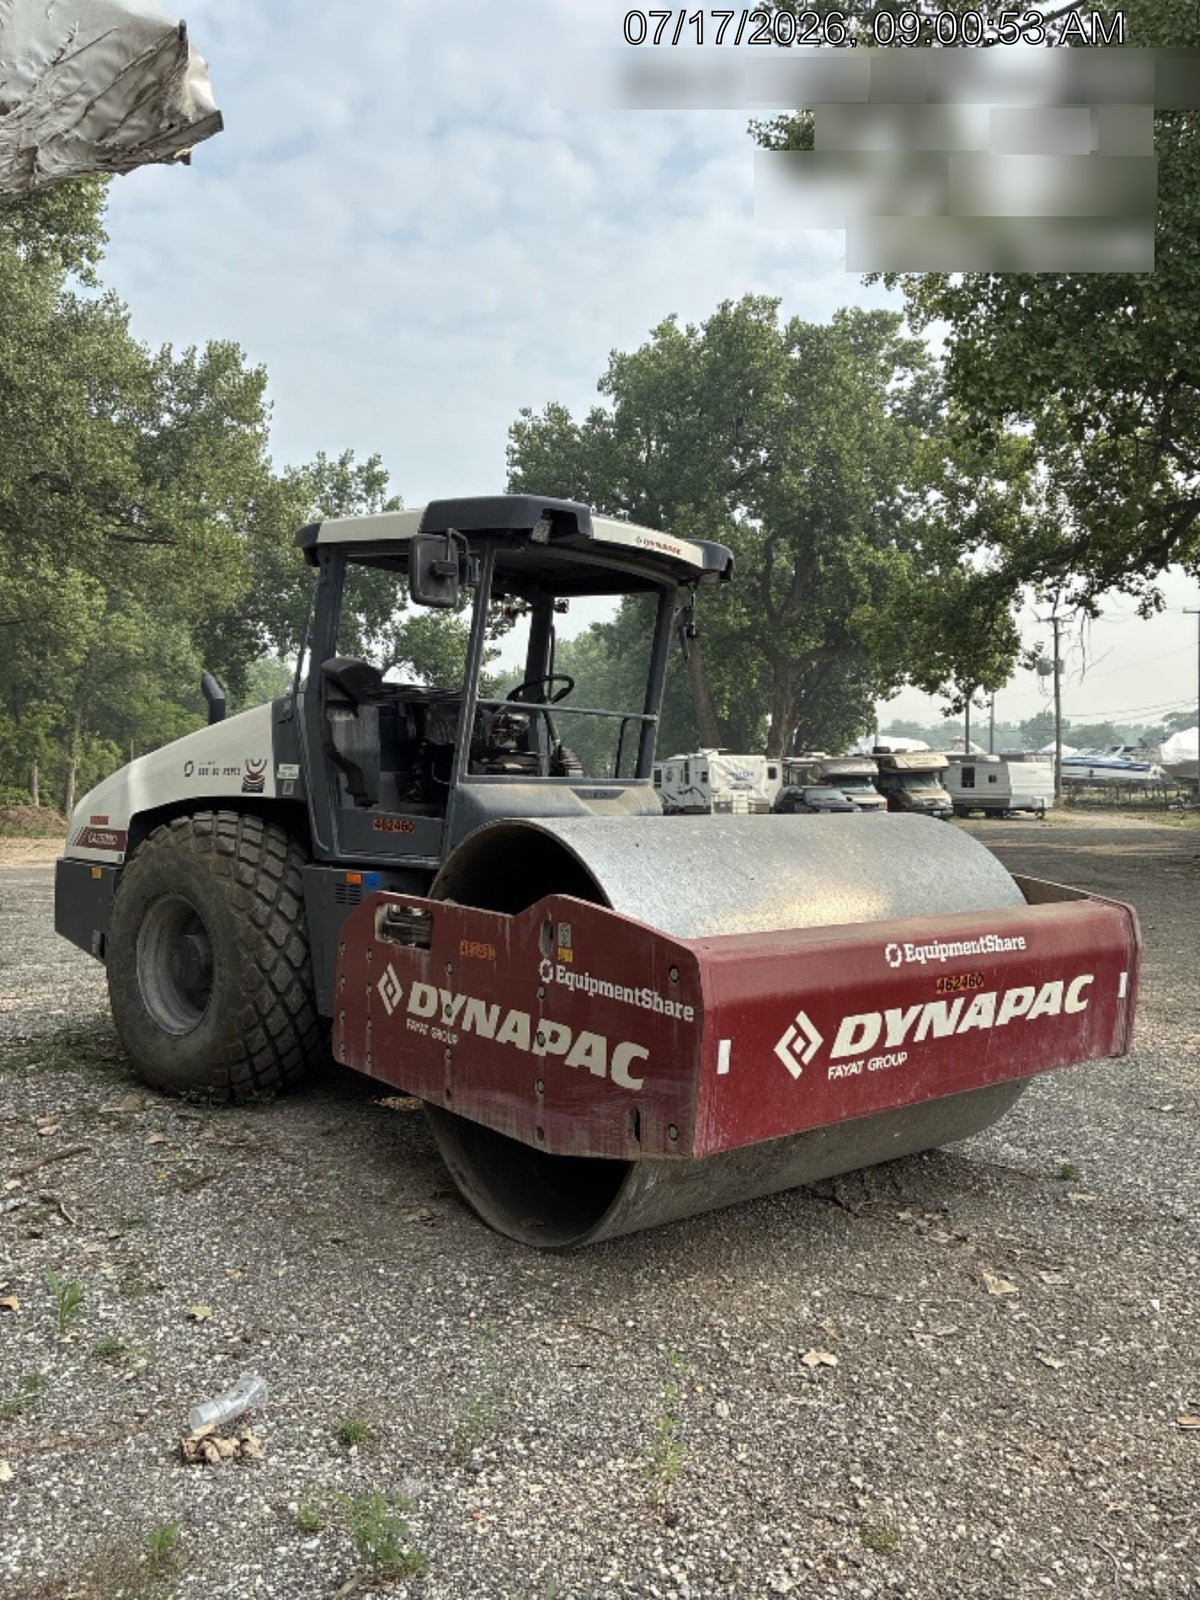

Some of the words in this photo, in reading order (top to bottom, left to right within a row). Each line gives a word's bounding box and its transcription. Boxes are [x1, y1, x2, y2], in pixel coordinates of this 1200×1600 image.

[903, 934, 1027, 965] EquipmentShare
[555, 964, 694, 1023] EquipmentShare
[936, 973, 984, 993] 462460
[406, 980, 650, 1091] DYNAPAC
[829, 974, 1095, 1059] DYNAPAC
[827, 1060, 865, 1081] FAYAT
[867, 1051, 908, 1072] GROUP
